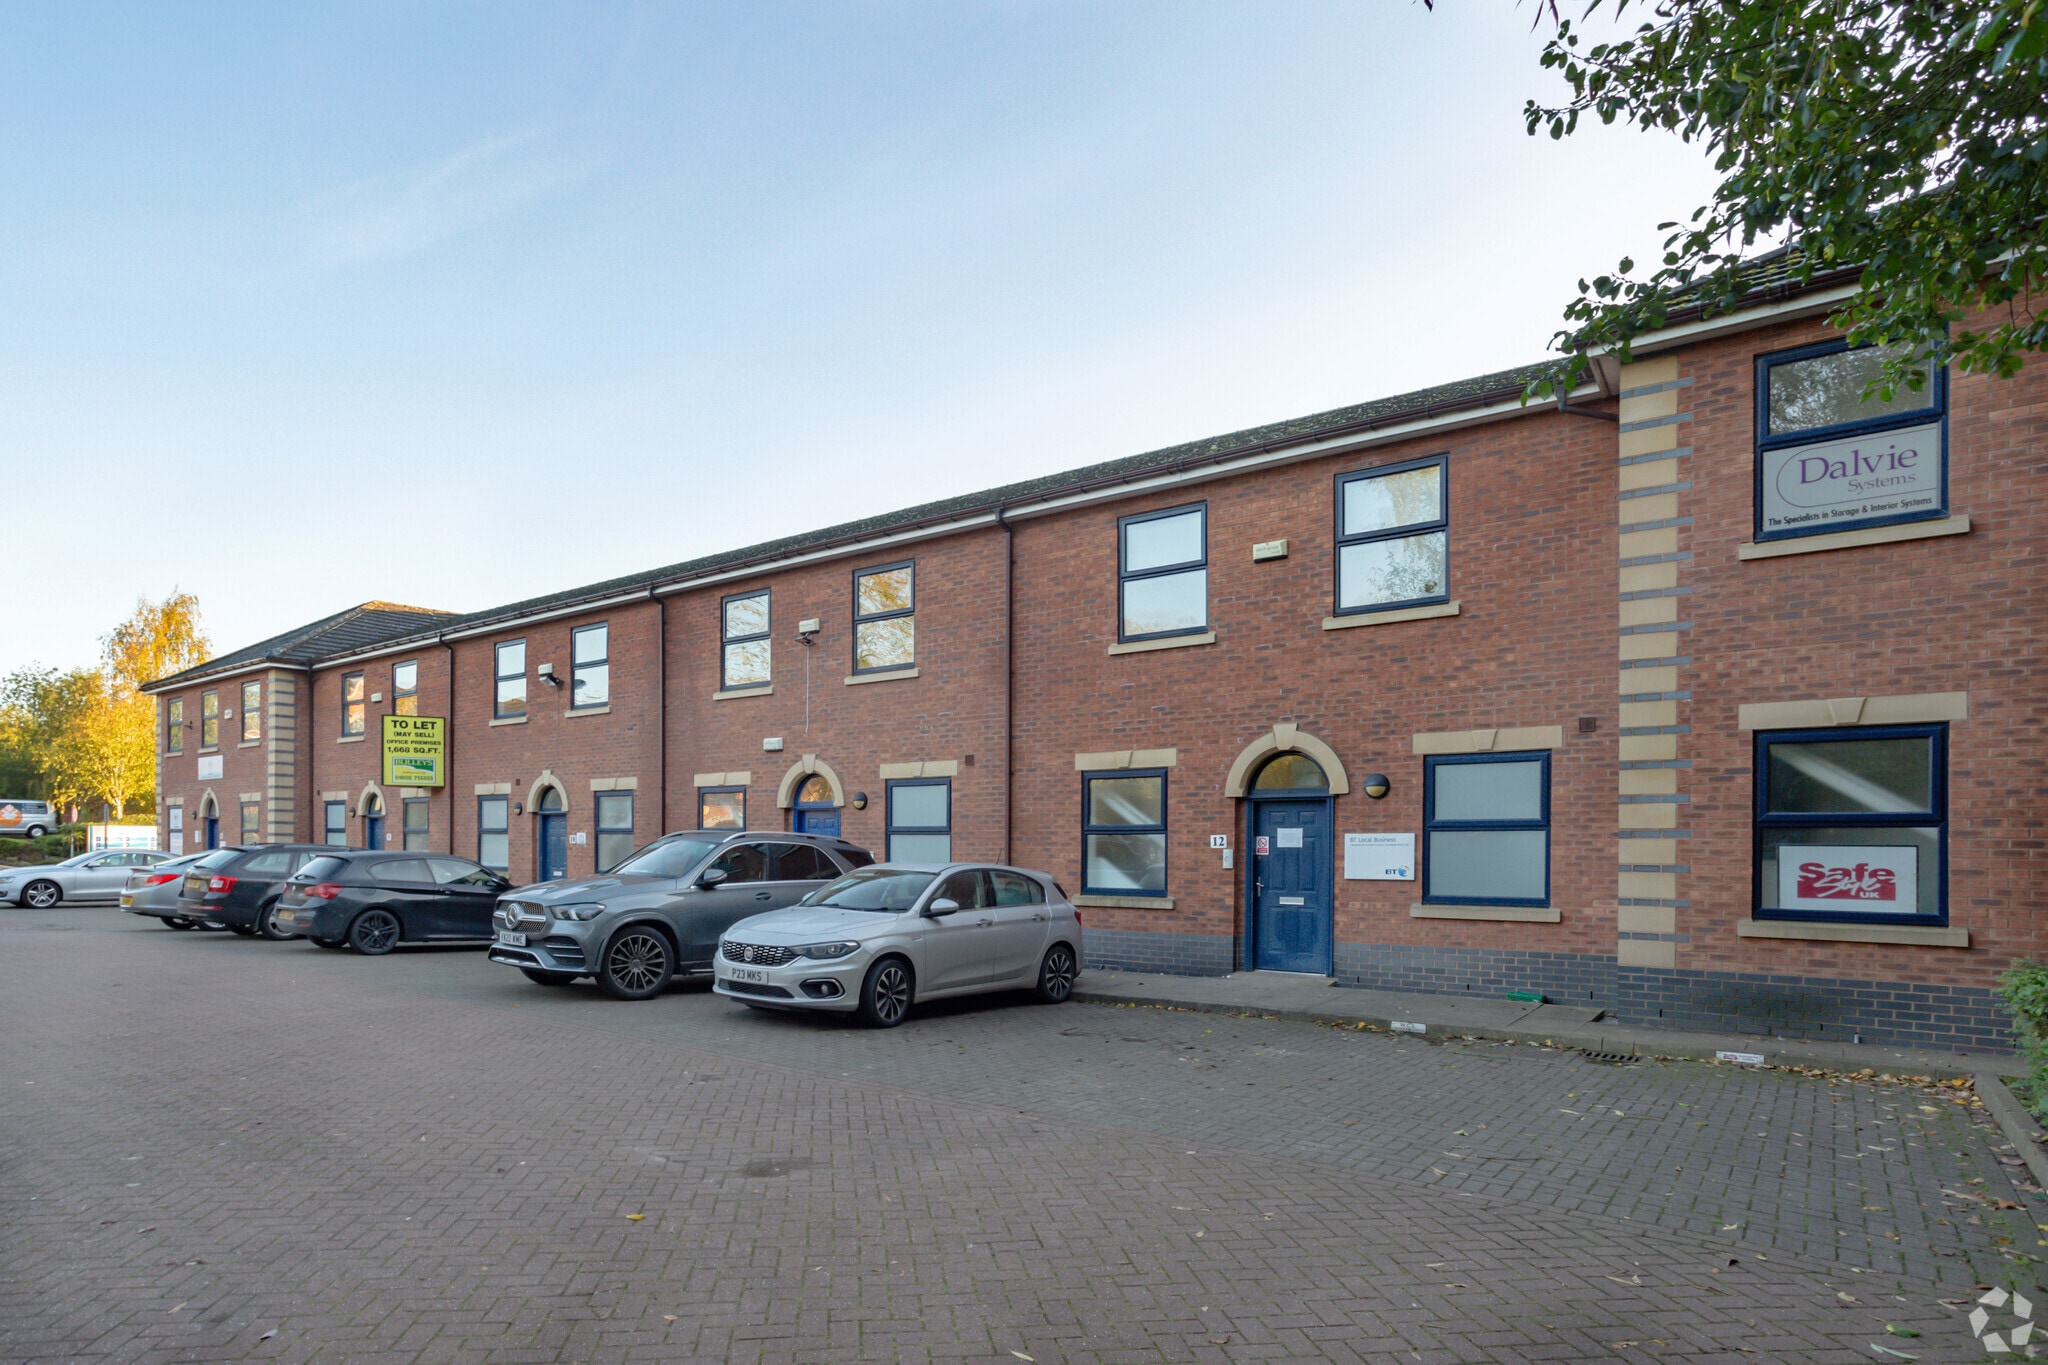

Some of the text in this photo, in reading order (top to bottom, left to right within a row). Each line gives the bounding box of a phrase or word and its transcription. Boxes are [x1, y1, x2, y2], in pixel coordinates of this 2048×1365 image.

[1799, 445, 1918, 485] Dalvie
[1848, 473, 1916, 495] Systems
[1769, 496, 1932, 526] The Specialists in Storage & Interior Systems
[391, 720, 437, 730] TO LET
[1212, 836, 1225, 847] 12
[1798, 862, 1896, 885] Safe
[1859, 891, 1880, 899] UK
[732, 968, 762, 981] P23 MKS
